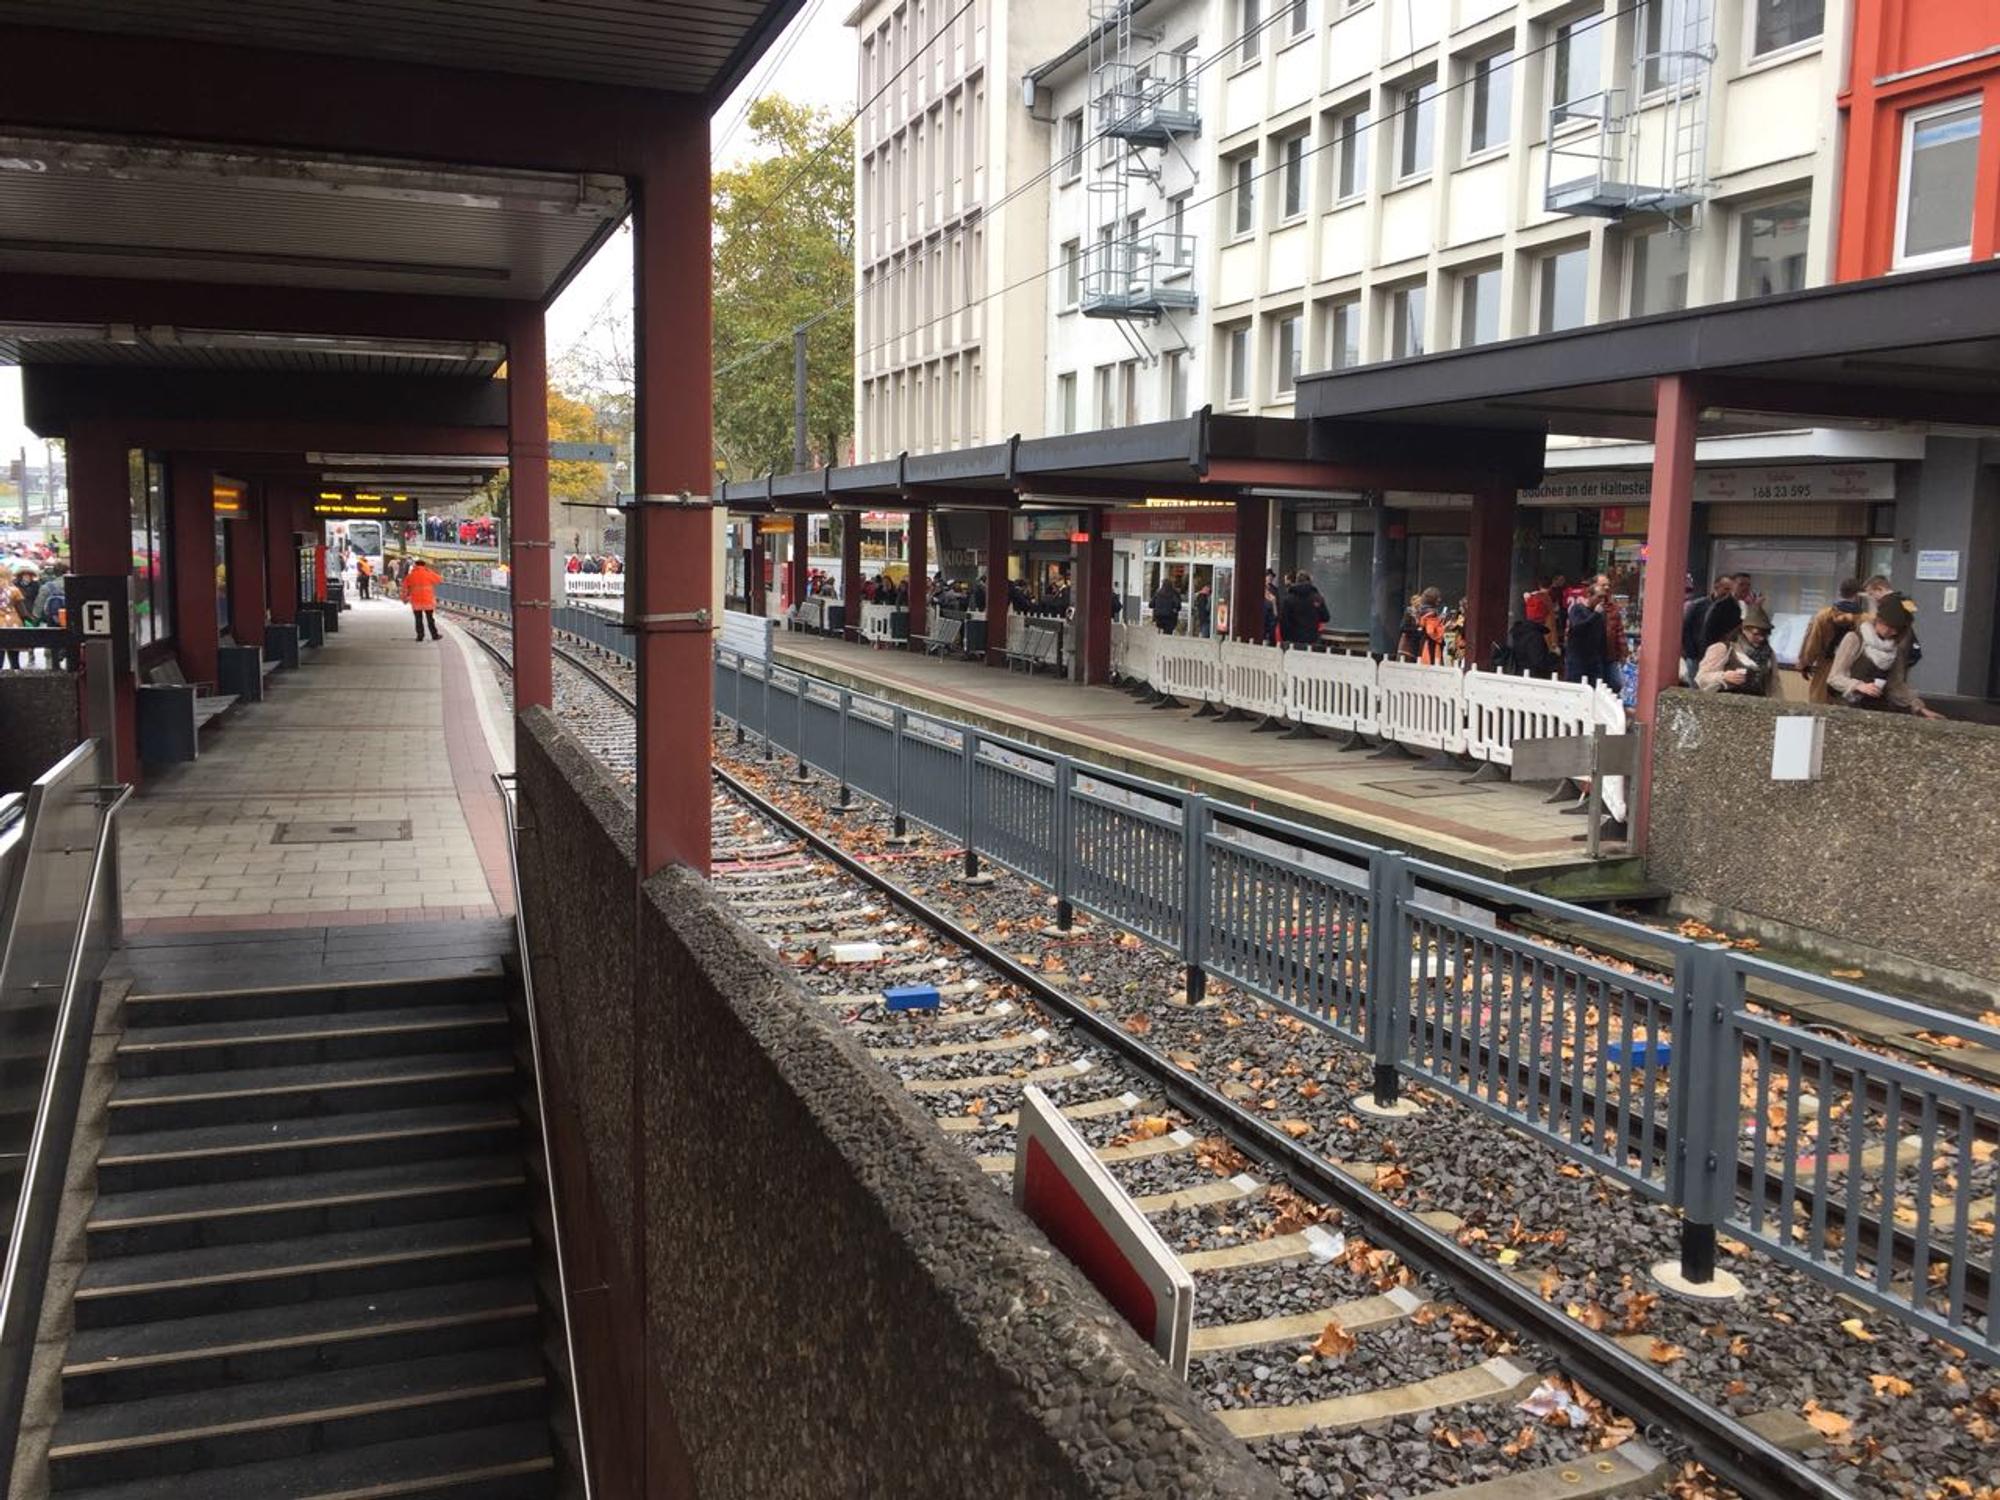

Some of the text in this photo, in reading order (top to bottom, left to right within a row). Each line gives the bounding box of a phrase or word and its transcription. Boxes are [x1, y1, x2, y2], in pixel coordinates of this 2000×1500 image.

[1566, 486, 1579, 497] an
[1582, 483, 1598, 497] der
[1753, 485, 1811, 498] 168 23 595
[88, 604, 104, 631] F
